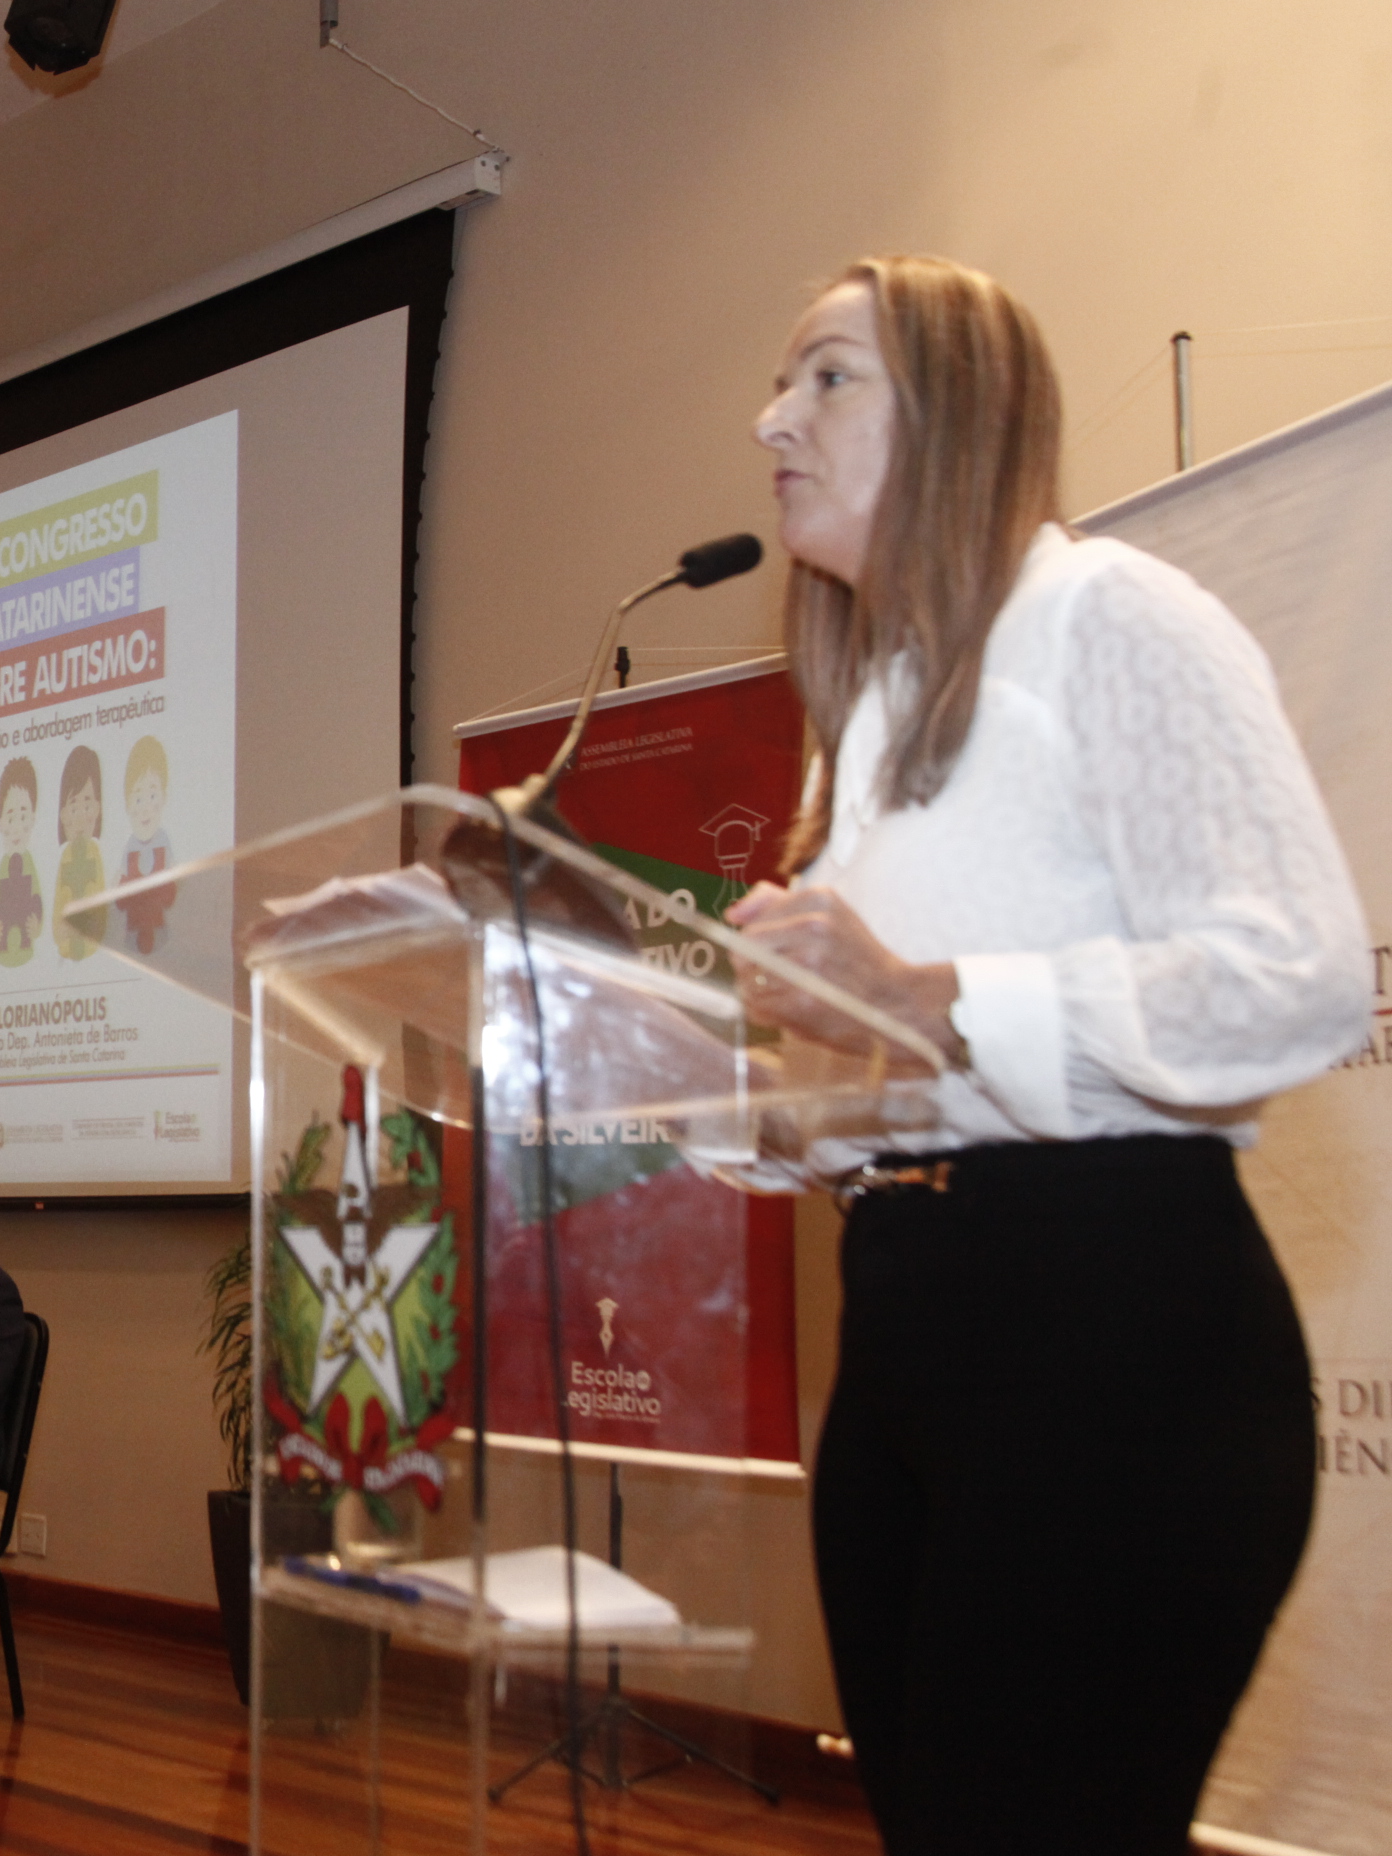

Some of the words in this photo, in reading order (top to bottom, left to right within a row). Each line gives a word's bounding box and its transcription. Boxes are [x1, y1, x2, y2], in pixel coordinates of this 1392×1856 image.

[32, 629, 157, 698] AUTISMO:
[12, 729, 20, 747] e
[22, 711, 92, 741] abordagem
[95, 690, 165, 729] terapêutica
[8, 1032, 30, 1054] Dep.
[33, 1028, 84, 1048] Antonieta
[86, 1025, 100, 1044] de
[103, 1023, 139, 1043] Barros
[57, 1052, 67, 1065] de
[69, 1050, 90, 1064] Santa
[92, 1047, 126, 1063] Catarina
[571, 1360, 636, 1388] Escola
[561, 1386, 662, 1417] egislativo
